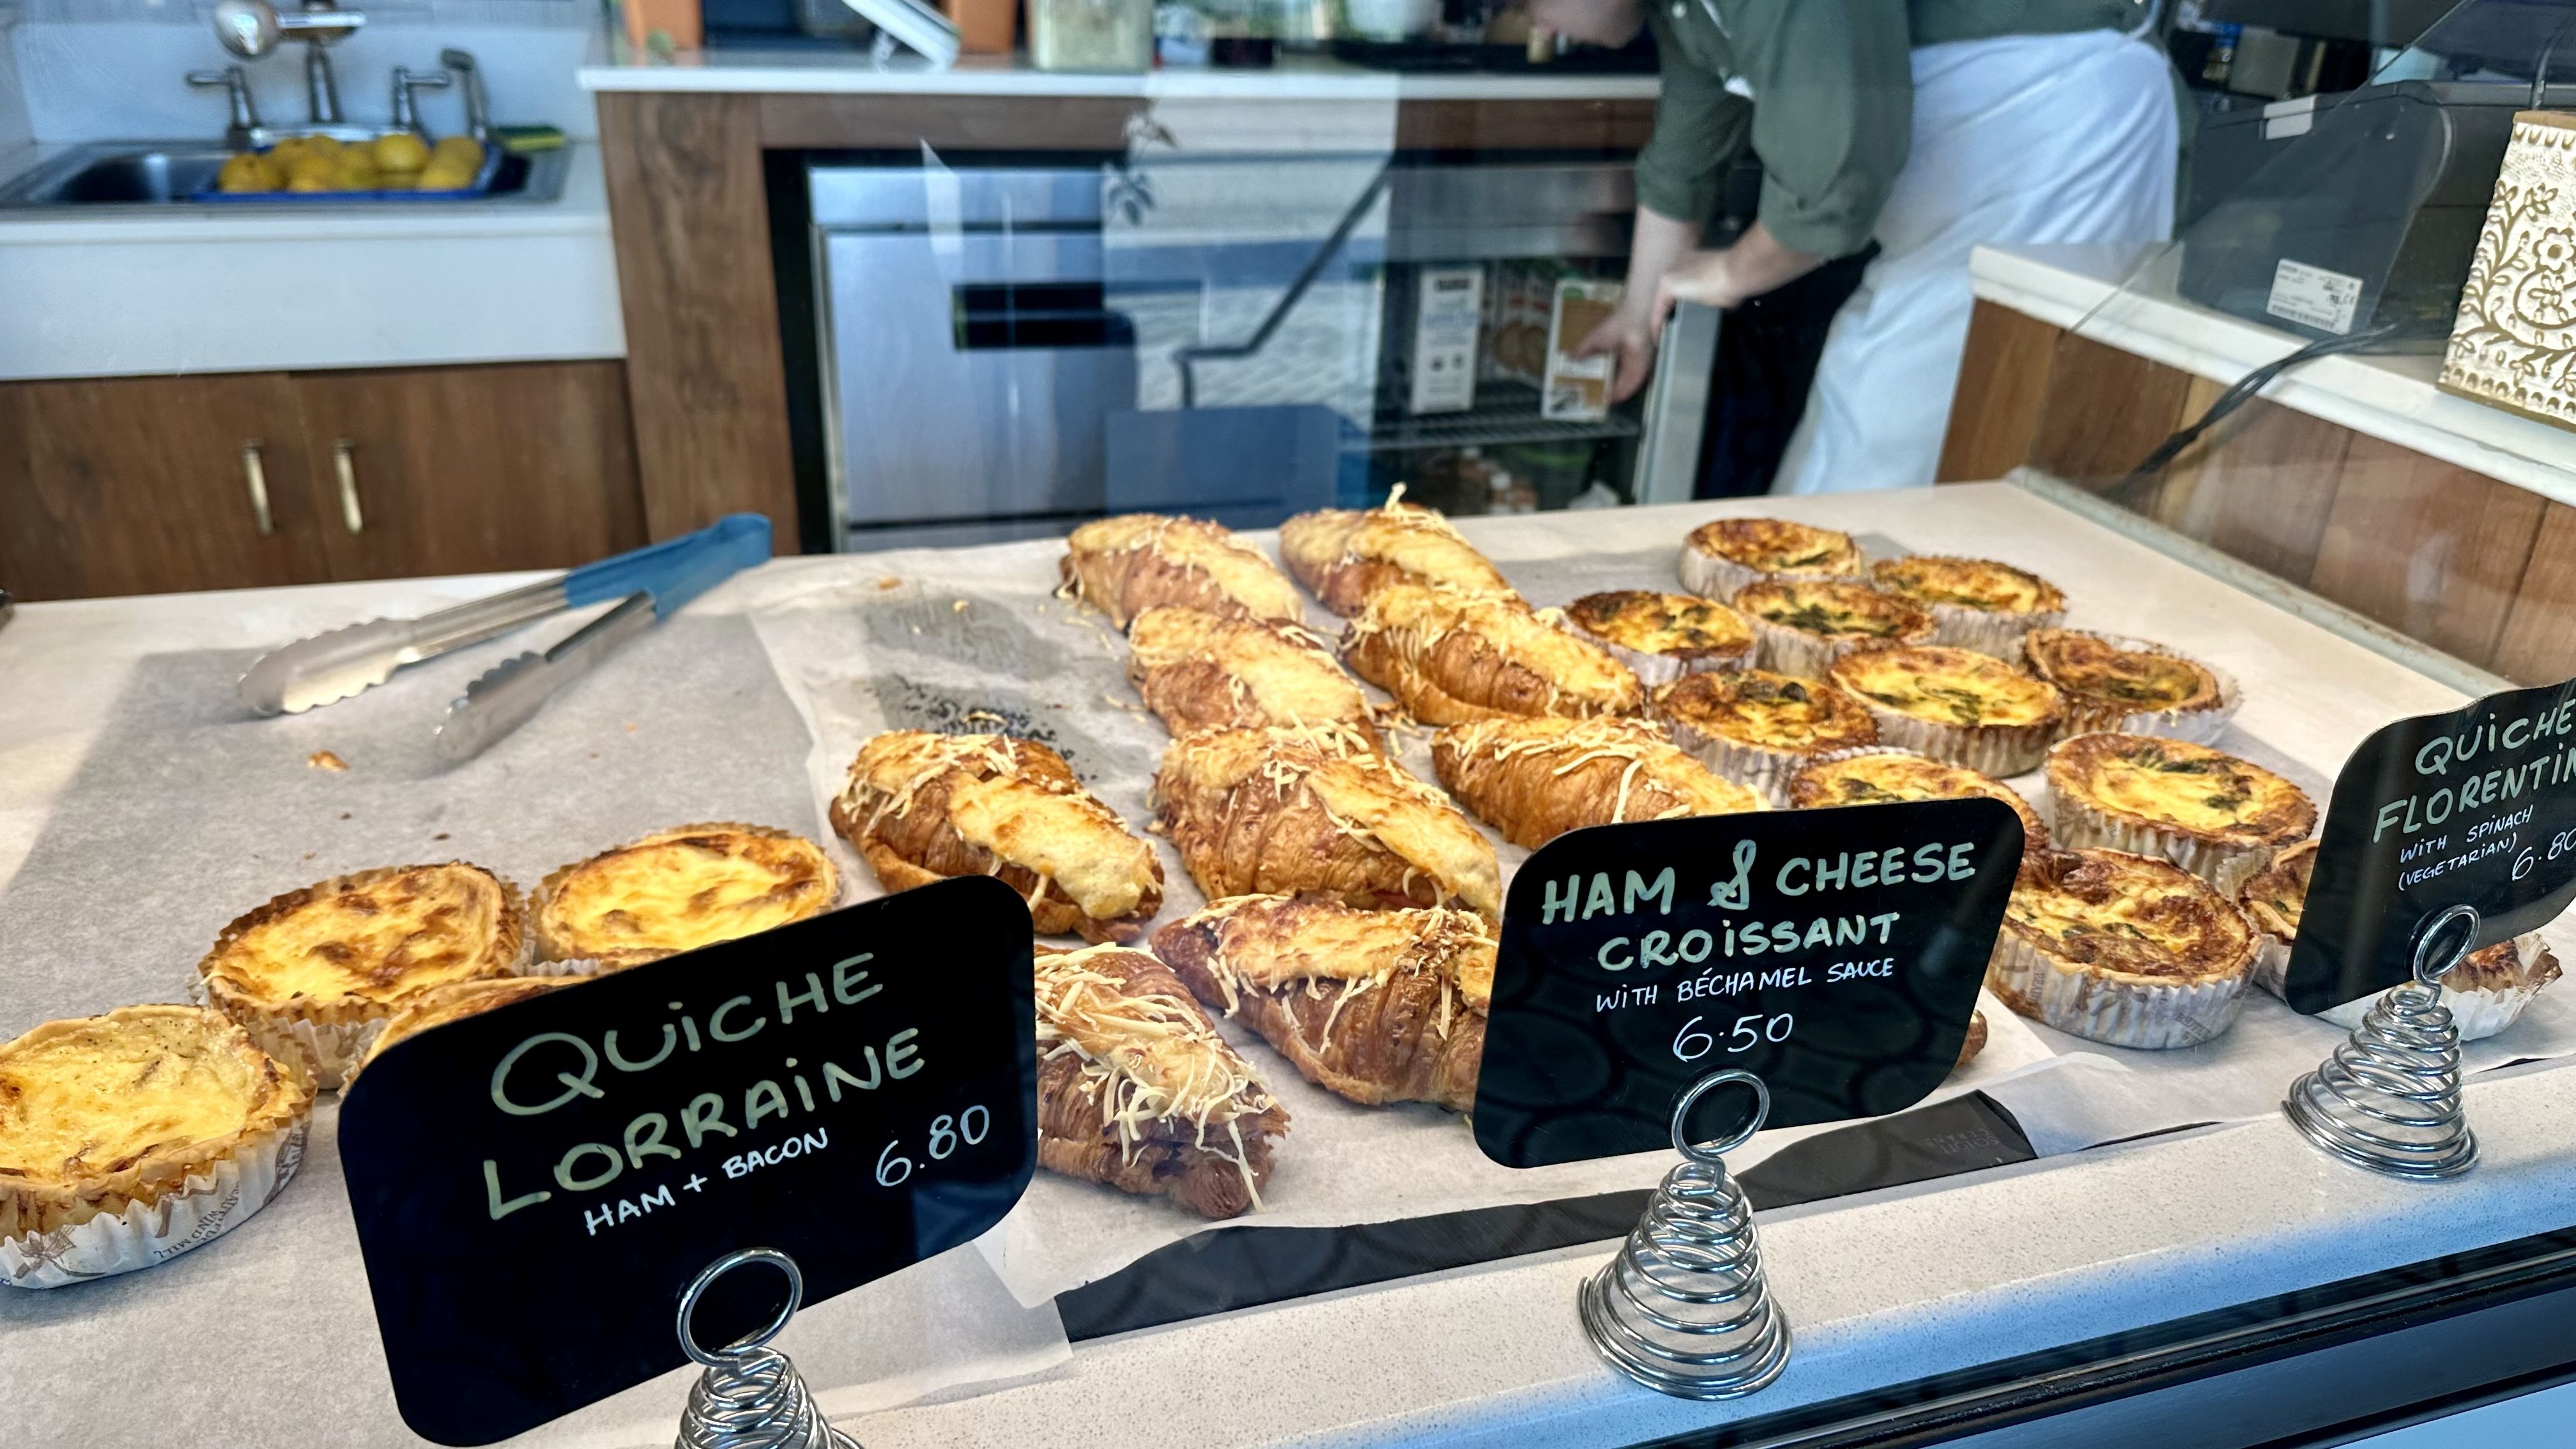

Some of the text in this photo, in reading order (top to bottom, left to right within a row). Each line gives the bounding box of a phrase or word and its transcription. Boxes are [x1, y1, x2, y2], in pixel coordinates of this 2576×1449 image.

[1541, 839, 1977, 925] HAM & CHEESE
[1676, 966, 1813, 1004] BÉCHAMEL
[1826, 957, 1894, 983] SAUCE
[583, 1127, 829, 1236] HAM + BACON
[875, 1105, 990, 1188] 6.80
[192, 1209, 218, 1239] WIND
